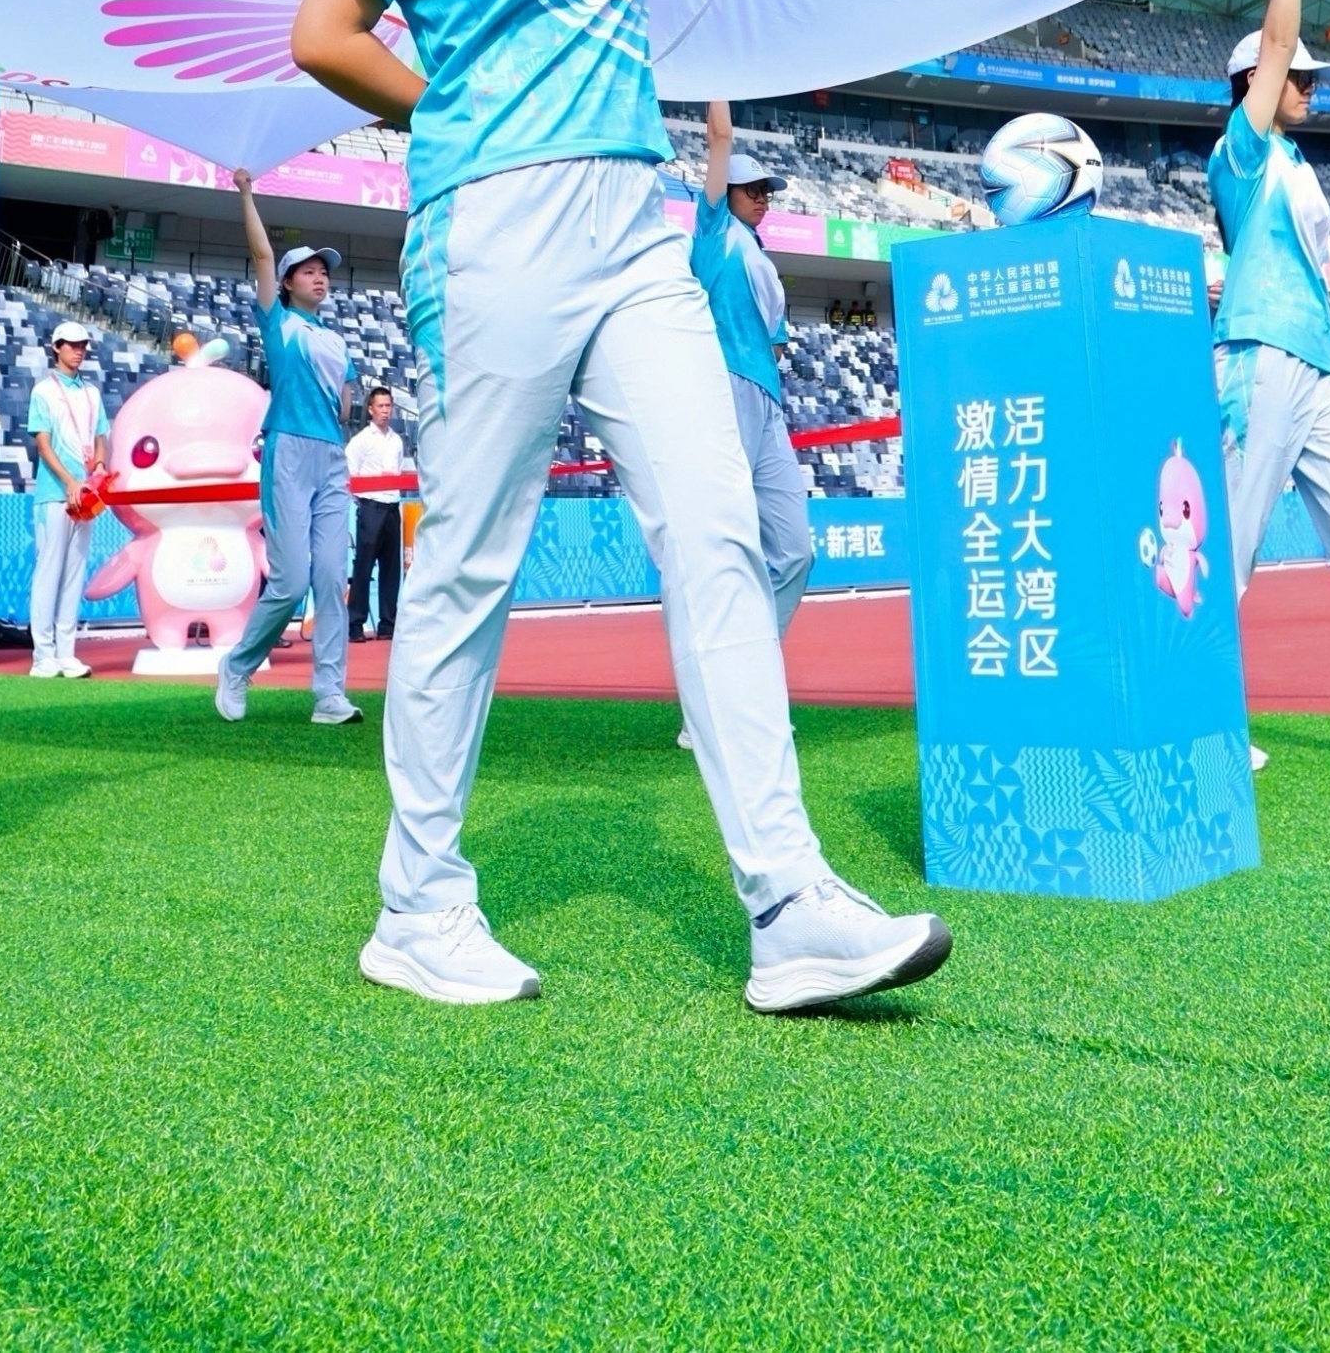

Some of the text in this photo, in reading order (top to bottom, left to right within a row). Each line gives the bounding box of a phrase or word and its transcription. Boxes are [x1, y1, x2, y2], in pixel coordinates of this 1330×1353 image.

[967, 261, 1059, 285] 中华人民共和国
[1139, 265, 1191, 284] 中华人民共和国
[968, 276, 1060, 299] 第十五届运动会
[1140, 279, 1192, 298] 第十五届运动会
[969, 301, 981, 309] The
[999, 295, 1027, 305] National
[1029, 293, 1051, 302] Games
[954, 400, 1011, 678] 激情全运会
[1003, 396, 1059, 678] 活力大湾区
